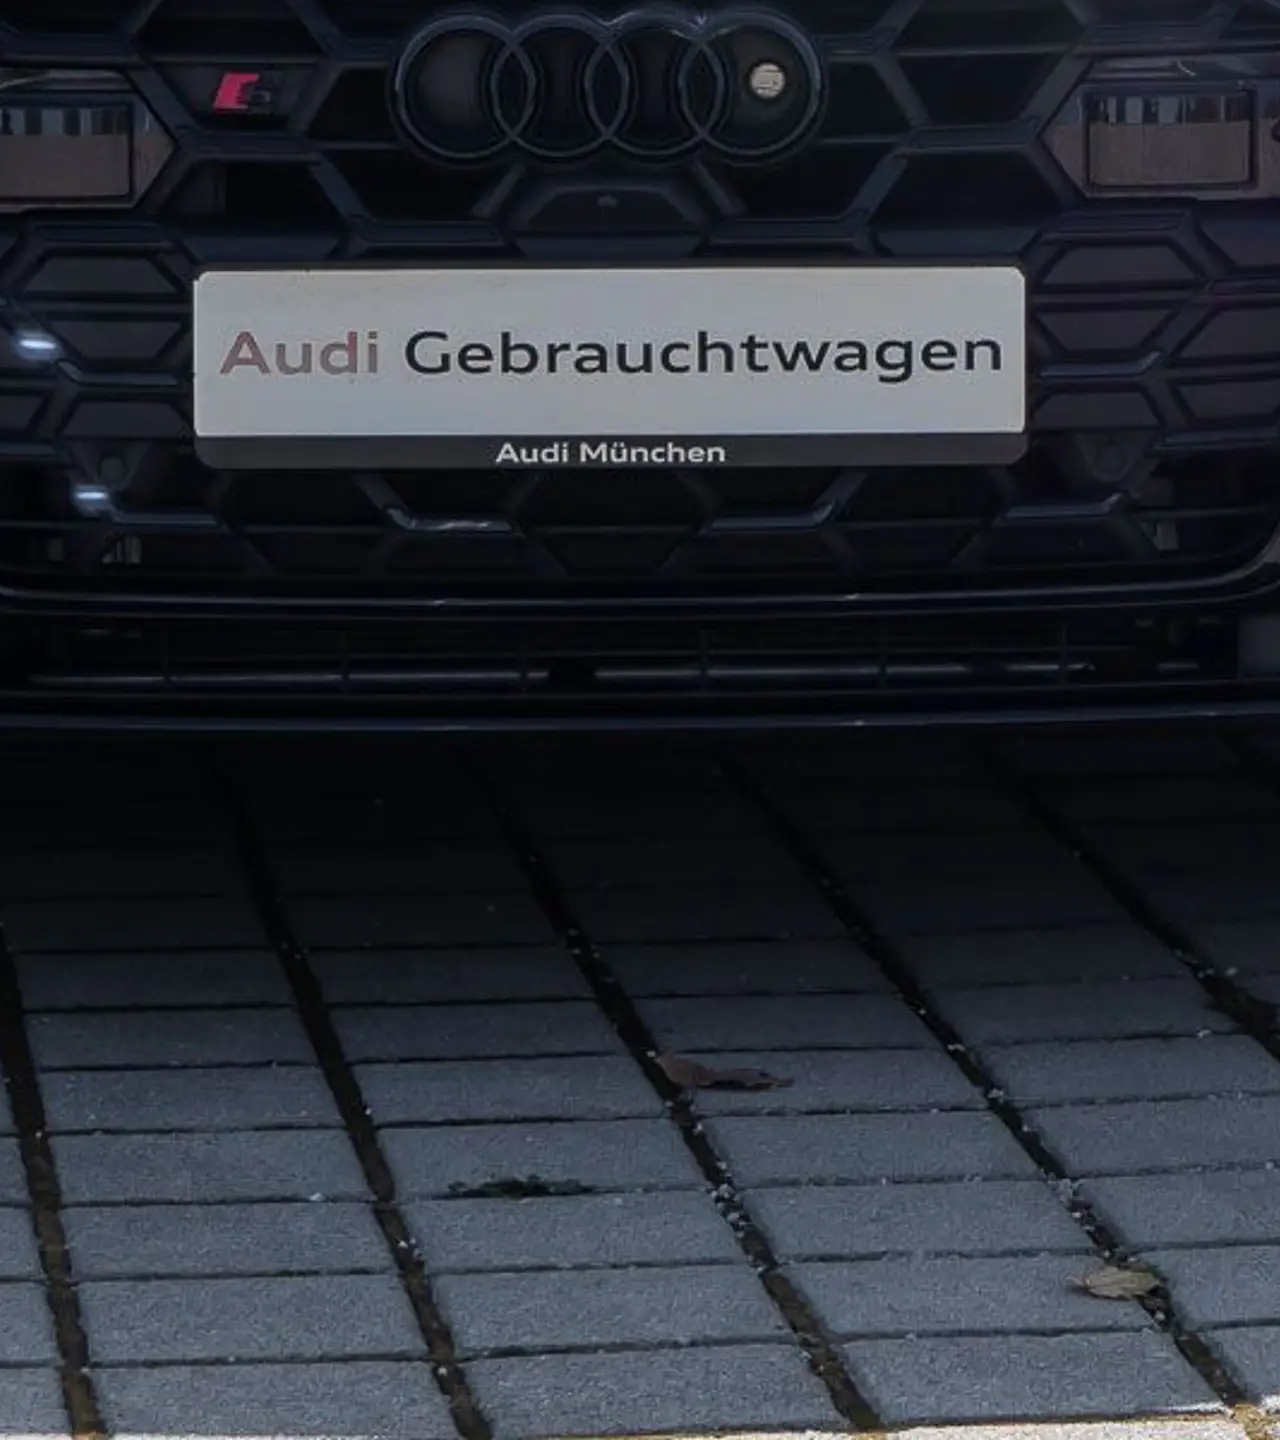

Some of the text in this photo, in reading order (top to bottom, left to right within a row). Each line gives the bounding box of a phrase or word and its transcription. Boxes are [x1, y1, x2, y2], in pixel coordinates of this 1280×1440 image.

[219, 330, 1003, 384] Audi Gebrauchtwagen
[495, 441, 726, 464] Audi München
